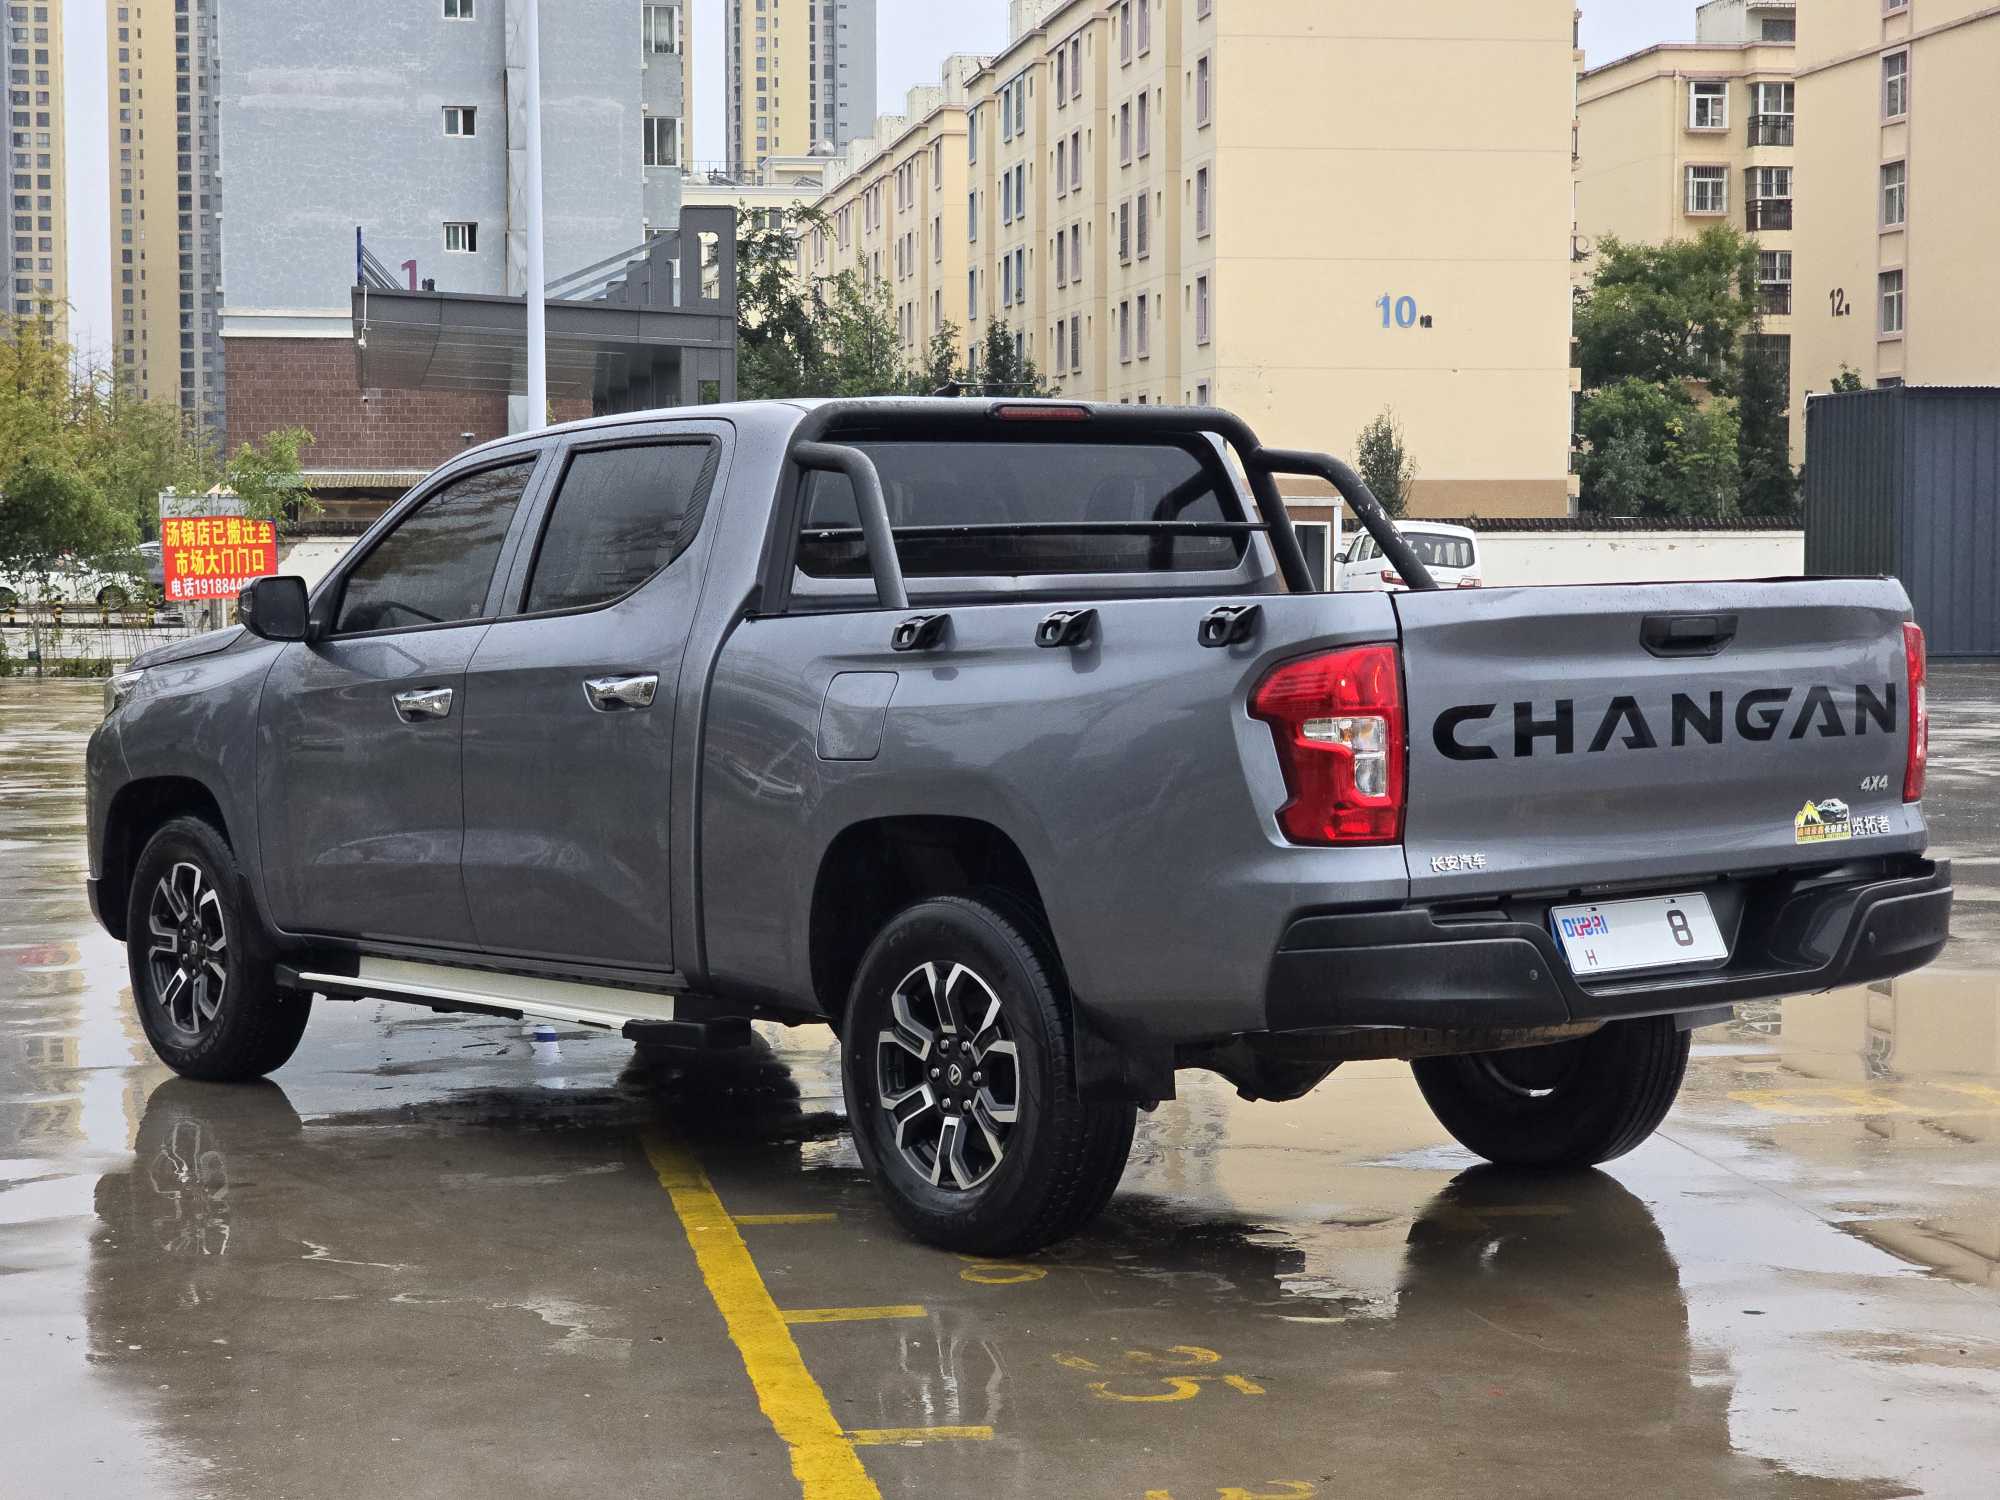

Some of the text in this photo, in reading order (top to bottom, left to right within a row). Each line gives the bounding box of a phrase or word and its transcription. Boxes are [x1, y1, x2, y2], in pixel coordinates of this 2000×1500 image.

[166, 518, 272, 547] 汤锅店已搬迁至
[175, 547, 264, 576] 市场大门门口
[1432, 682, 1897, 761] CHANGAN
[1430, 853, 1487, 872] 长安汽车
[1666, 909, 1694, 947] 8
[1584, 949, 1598, 965] H
